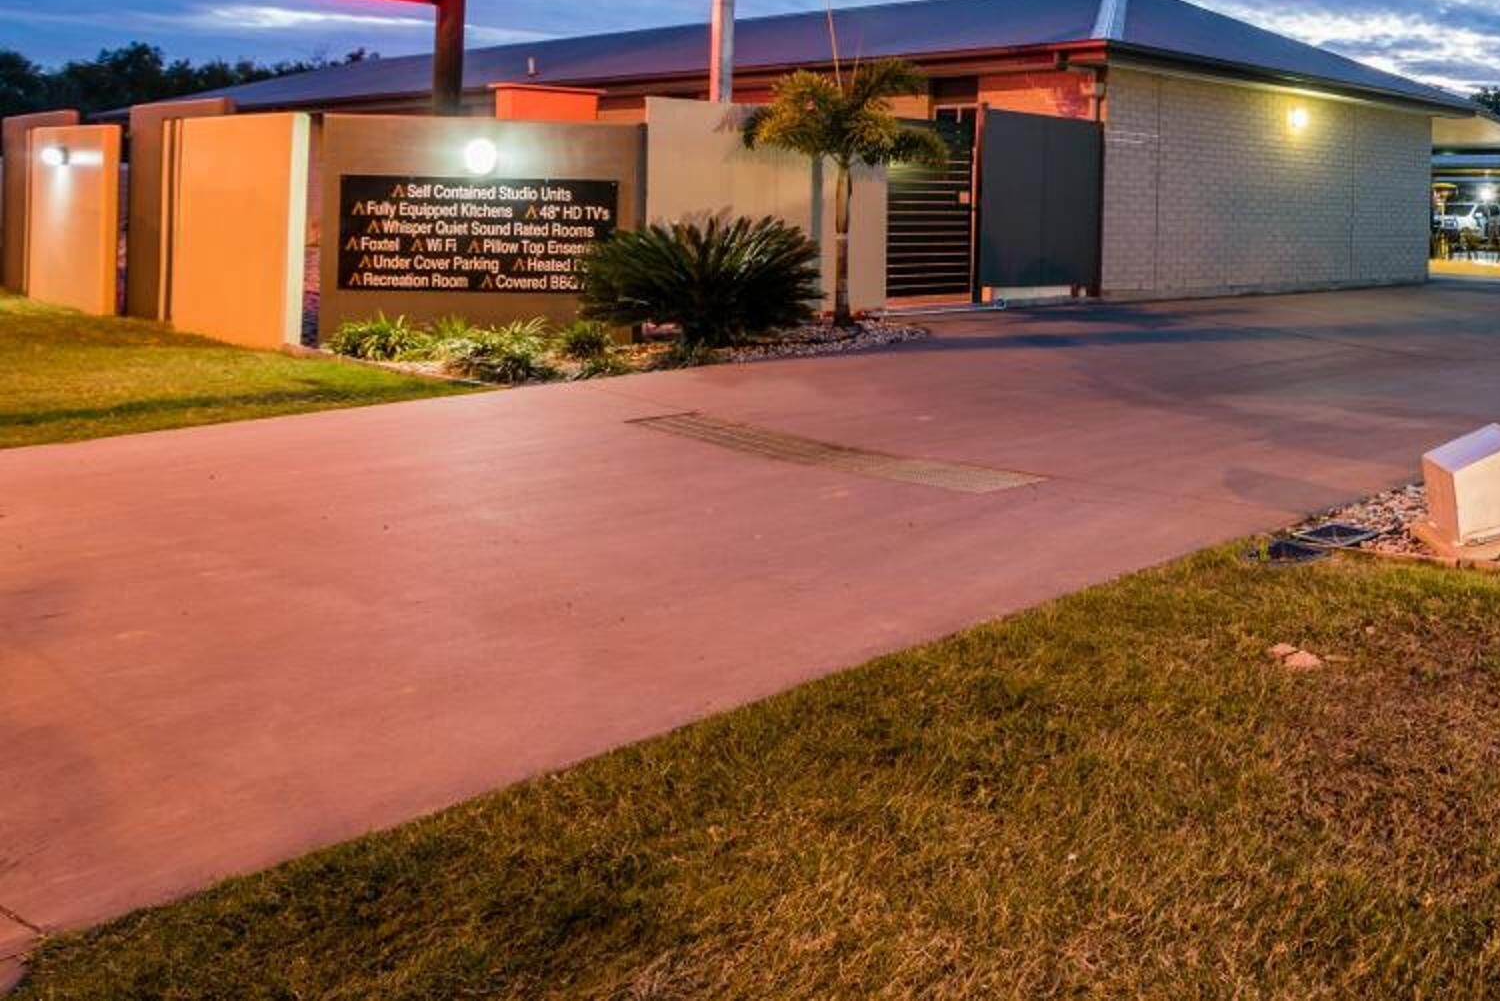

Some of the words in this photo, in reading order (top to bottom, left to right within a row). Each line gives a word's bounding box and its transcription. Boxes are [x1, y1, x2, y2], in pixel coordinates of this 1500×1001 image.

[407, 184, 432, 198] Self
[434, 184, 496, 199] Contained
[499, 186, 537, 200] Studio
[541, 187, 572, 201] Units
[367, 201, 396, 218] Fully
[399, 202, 458, 219] Equipped
[461, 203, 512, 218] Kitchens
[563, 206, 582, 219] HD
[381, 220, 432, 237] Whisper
[435, 221, 468, 235] Quiet
[471, 221, 510, 236] Sound
[513, 223, 548, 236] Rated
[552, 224, 594, 238] Rooms
[361, 237, 399, 251] Foxtel
[483, 239, 518, 254] Pillow
[520, 240, 544, 257] Top
[373, 255, 410, 269] Under
[413, 255, 450, 269] Cover
[453, 256, 499, 273] Parking
[527, 257, 570, 271] Heated
[363, 272, 429, 287] Recreation
[432, 273, 469, 288] Room
[495, 274, 547, 289] Covered
[549, 275, 578, 290] BBQ
